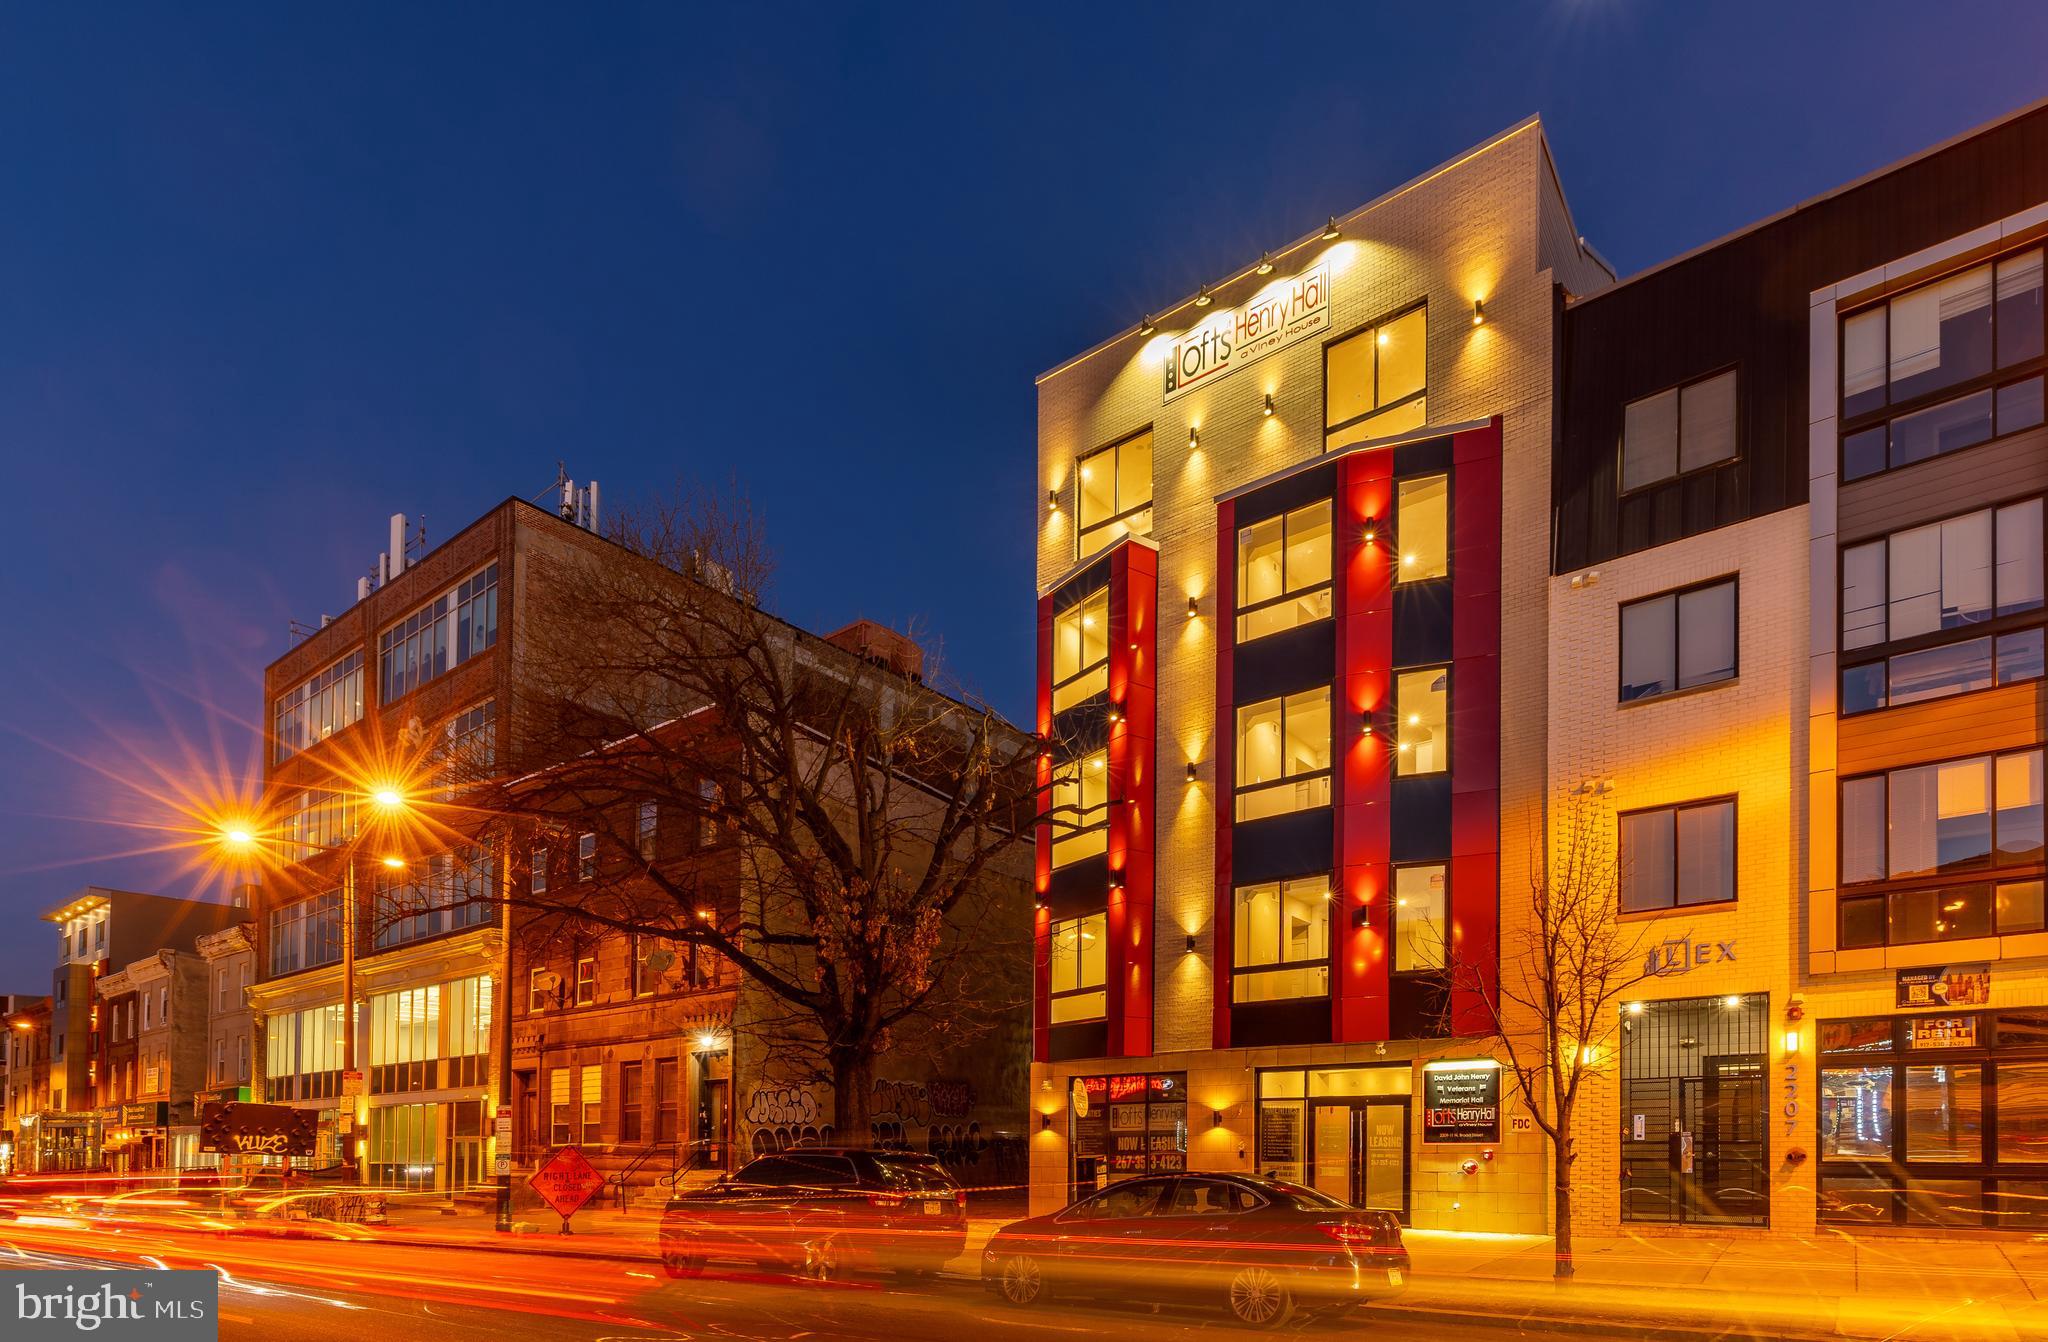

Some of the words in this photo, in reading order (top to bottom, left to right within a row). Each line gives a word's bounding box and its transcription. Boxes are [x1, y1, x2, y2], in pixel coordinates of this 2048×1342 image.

[1235, 299, 1289, 345] Henry
[1292, 271, 1327, 317] Hall
[1240, 350, 1248, 359] a
[1285, 316, 1320, 338] House
[1902, 974, 1928, 982] MANAGED
[1923, 1018, 1963, 1029] FOR
[1917, 1027, 1970, 1039] RENT
[1433, 1073, 1453, 1082] David
[1453, 1073, 1470, 1081] John
[1470, 1072, 1491, 1082] Henry
[1446, 1085, 1477, 1093] Veterans
[1470, 1096, 1484, 1104] Hall
[1151, 1108, 1171, 1122] enry
[1431, 1107, 1457, 1127] Lofts
[1456, 1107, 1481, 1123] Henry
[1480, 1107, 1496, 1120] Hall
[1512, 1118, 1530, 1129] FDC
[1375, 1124, 1395, 1135] NOW
[1117, 1136, 1139, 1151] NOW
[1369, 1136, 1402, 1148] LEASING
[1115, 1155, 1182, 1170] 267-353-4123
[543, 1172, 569, 1181] RIGHT
[573, 1171, 591, 1180] LANE
[553, 1183, 582, 1192] CLOSED
[554, 1194, 579, 1203] AHEAD
